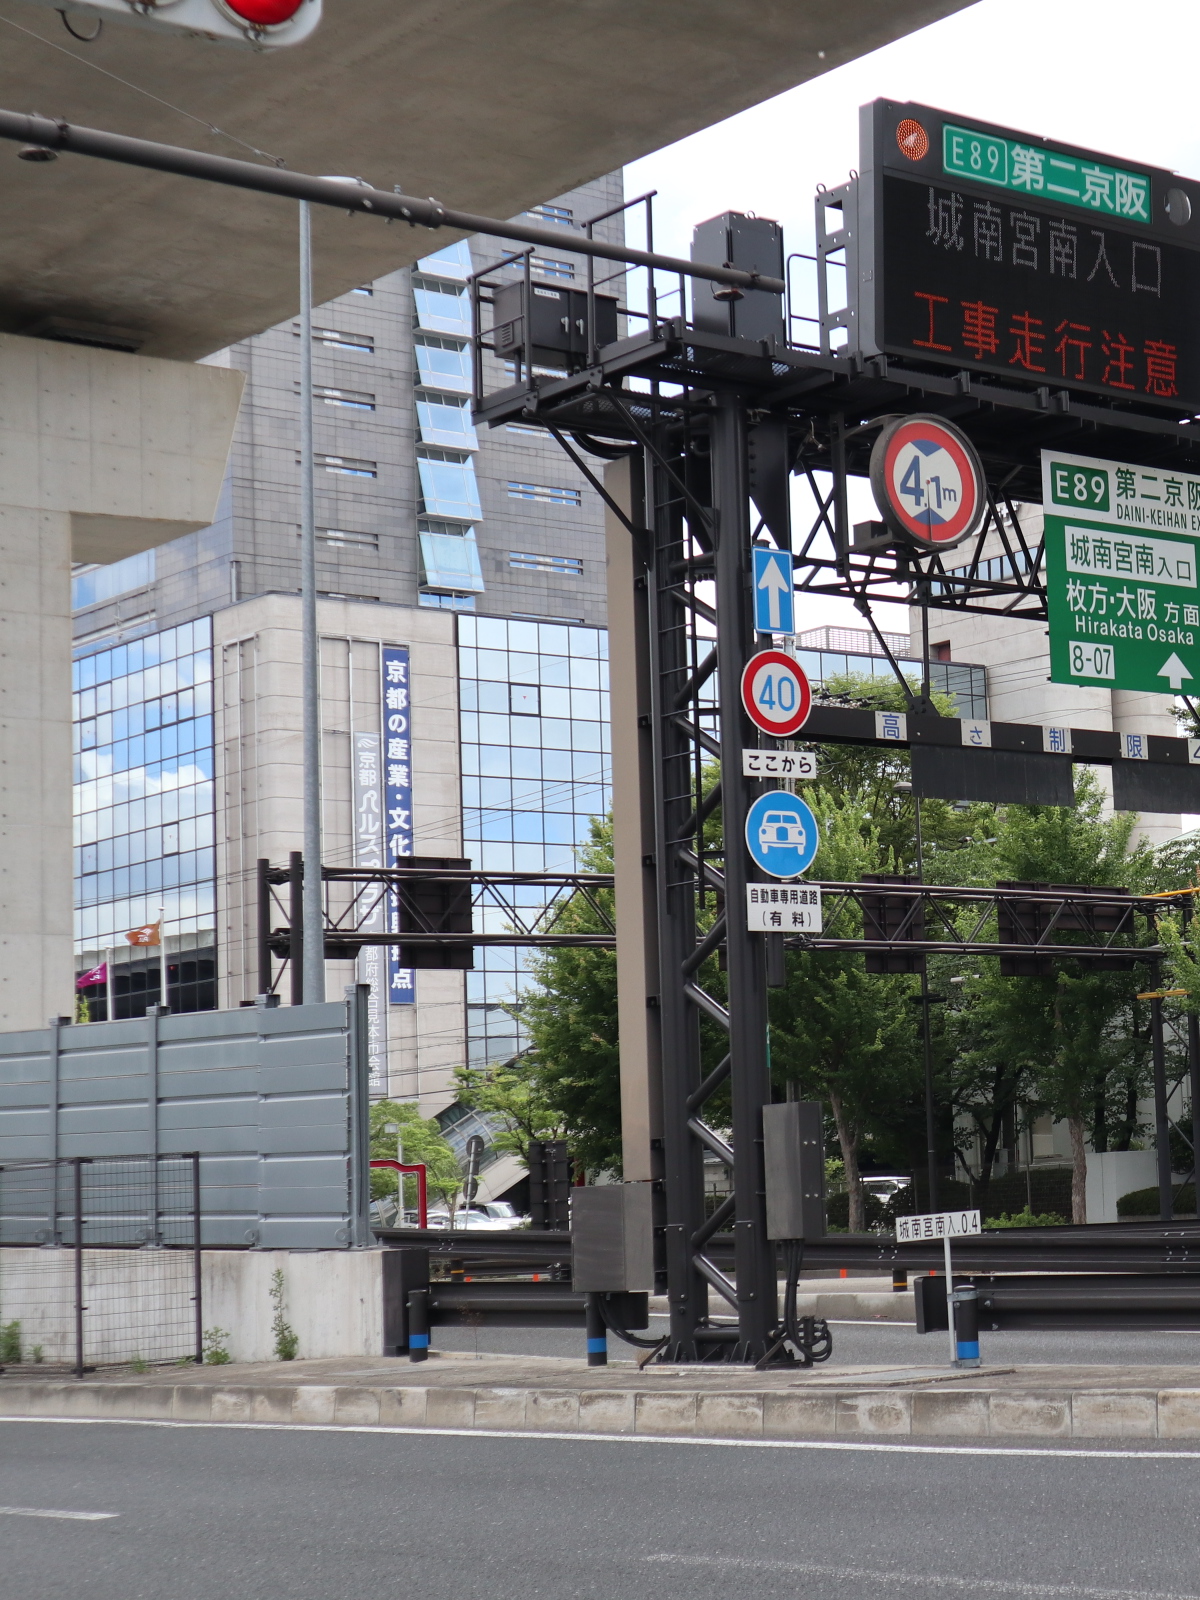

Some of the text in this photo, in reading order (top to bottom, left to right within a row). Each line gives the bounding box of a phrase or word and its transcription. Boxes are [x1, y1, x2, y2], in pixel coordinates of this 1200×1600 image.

[952, 135, 1149, 219] E89 第二京阪
[925, 186, 1162, 298] 城南宮南入口
[912, 291, 1179, 397] 工事走行注意
[1055, 469, 1106, 503] E89
[1116, 503, 1188, 530] DAINI-KEIHAN
[1069, 532, 1192, 582] 城南宮南入口
[1074, 614, 1195, 646] Hirakata Osaka
[1072, 644, 1112, 676] 8-07
[758, 674, 796, 712] 40
[748, 754, 813, 775] ここから
[750, 887, 819, 906] 自動車専用道路
